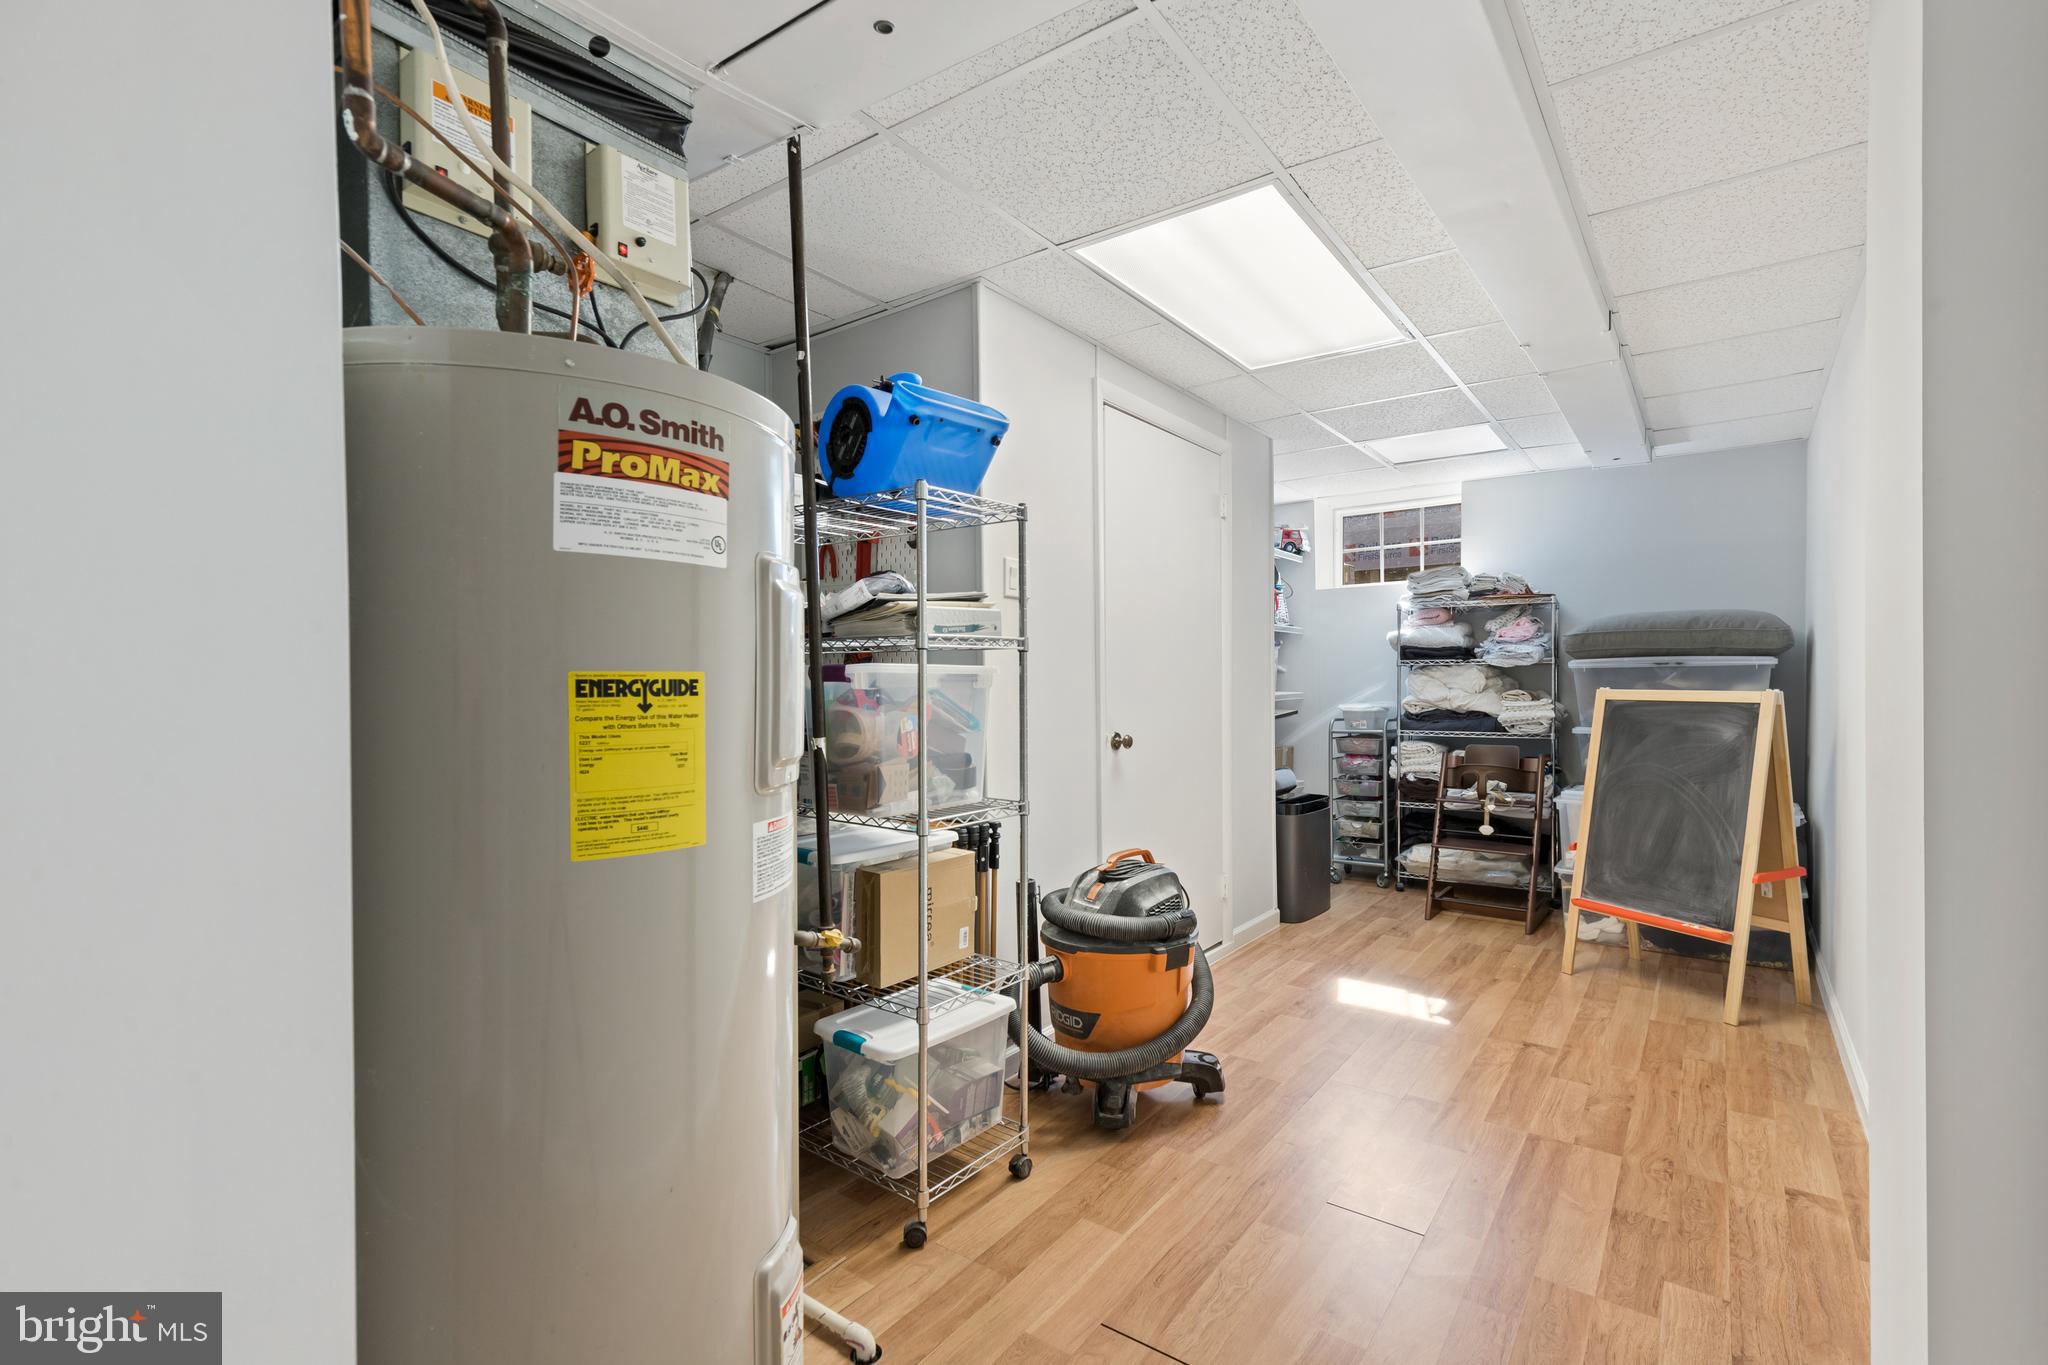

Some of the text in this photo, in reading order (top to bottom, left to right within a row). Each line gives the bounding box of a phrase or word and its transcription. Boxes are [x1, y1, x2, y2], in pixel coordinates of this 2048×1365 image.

[568, 397, 725, 452] A.O. Smith
[571, 439, 721, 494] ProMax
[575, 679, 699, 698] ENERGYGUIDE
[616, 714, 636, 722] Energy
